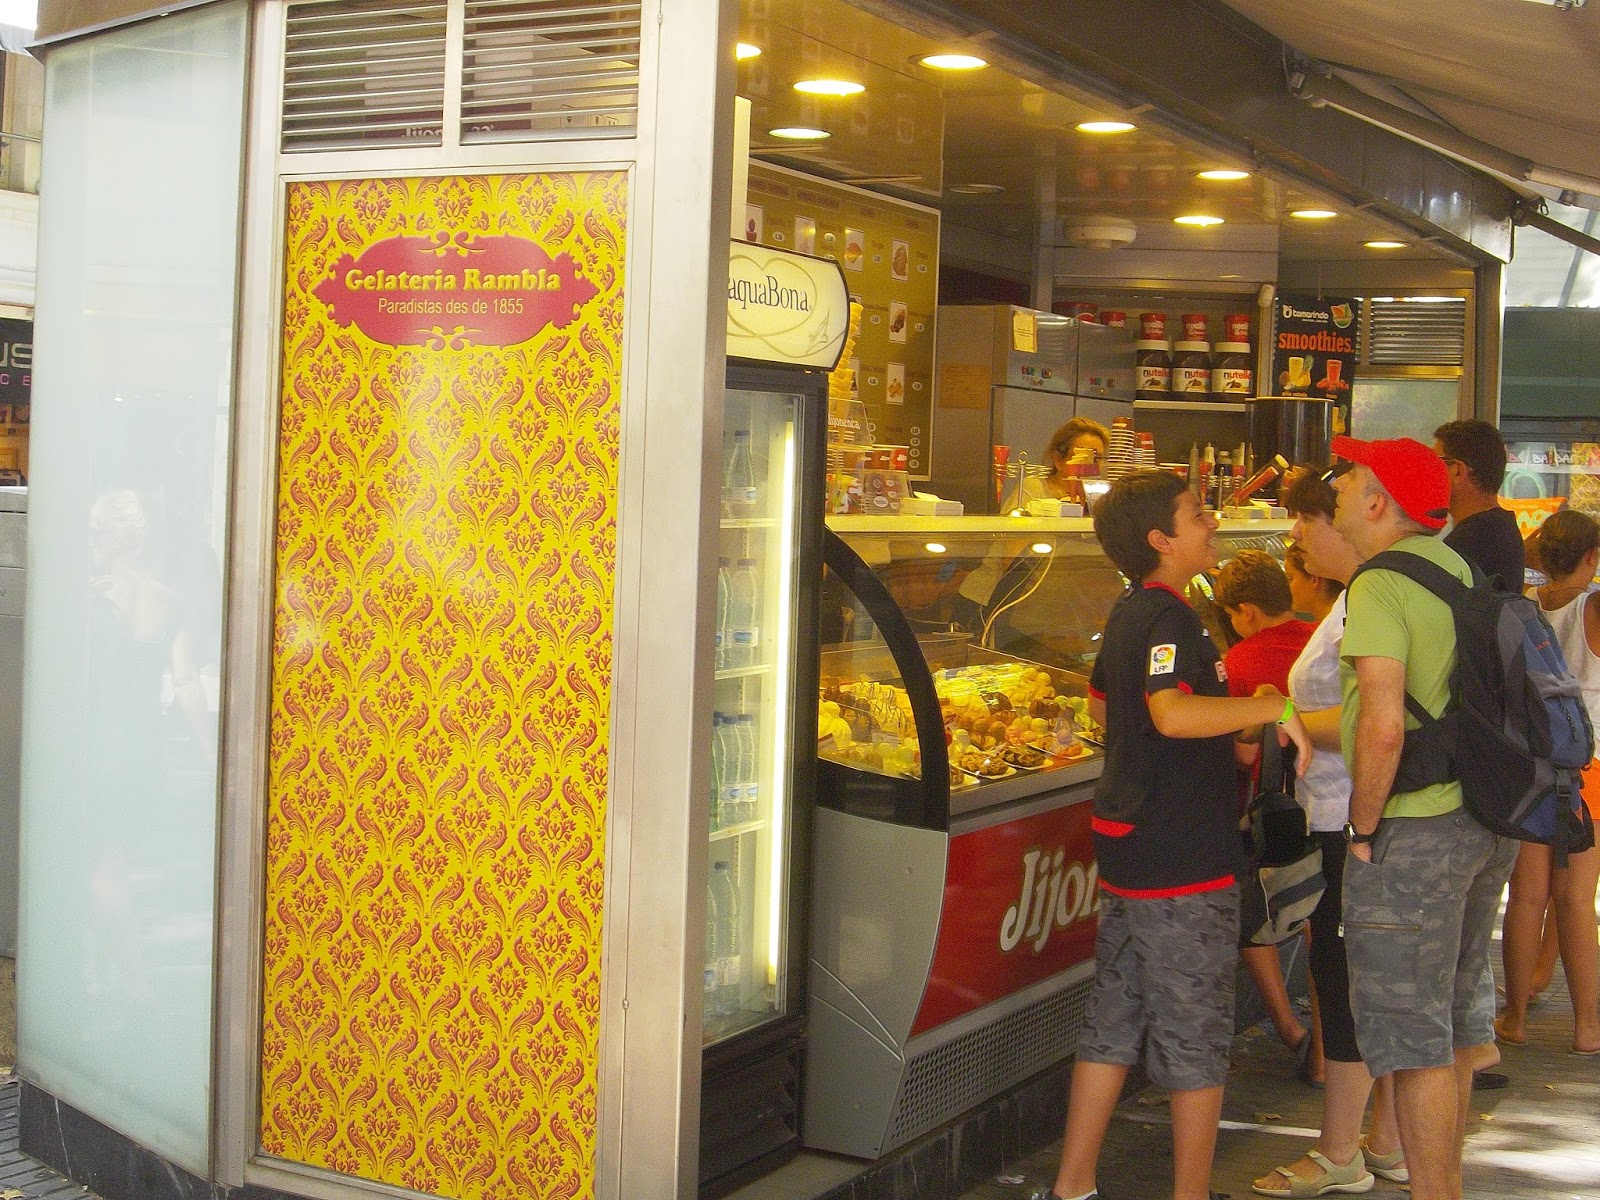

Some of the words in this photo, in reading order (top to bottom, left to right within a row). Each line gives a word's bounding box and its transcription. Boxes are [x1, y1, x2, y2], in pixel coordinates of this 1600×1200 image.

[345, 269, 457, 291] Gelateria
[463, 268, 561, 291] Rambla
[728, 275, 809, 312] aquaBona
[378, 298, 442, 315] Paradistas
[445, 298, 468, 315] des
[471, 298, 488, 315] de
[492, 298, 523, 314] 1855
